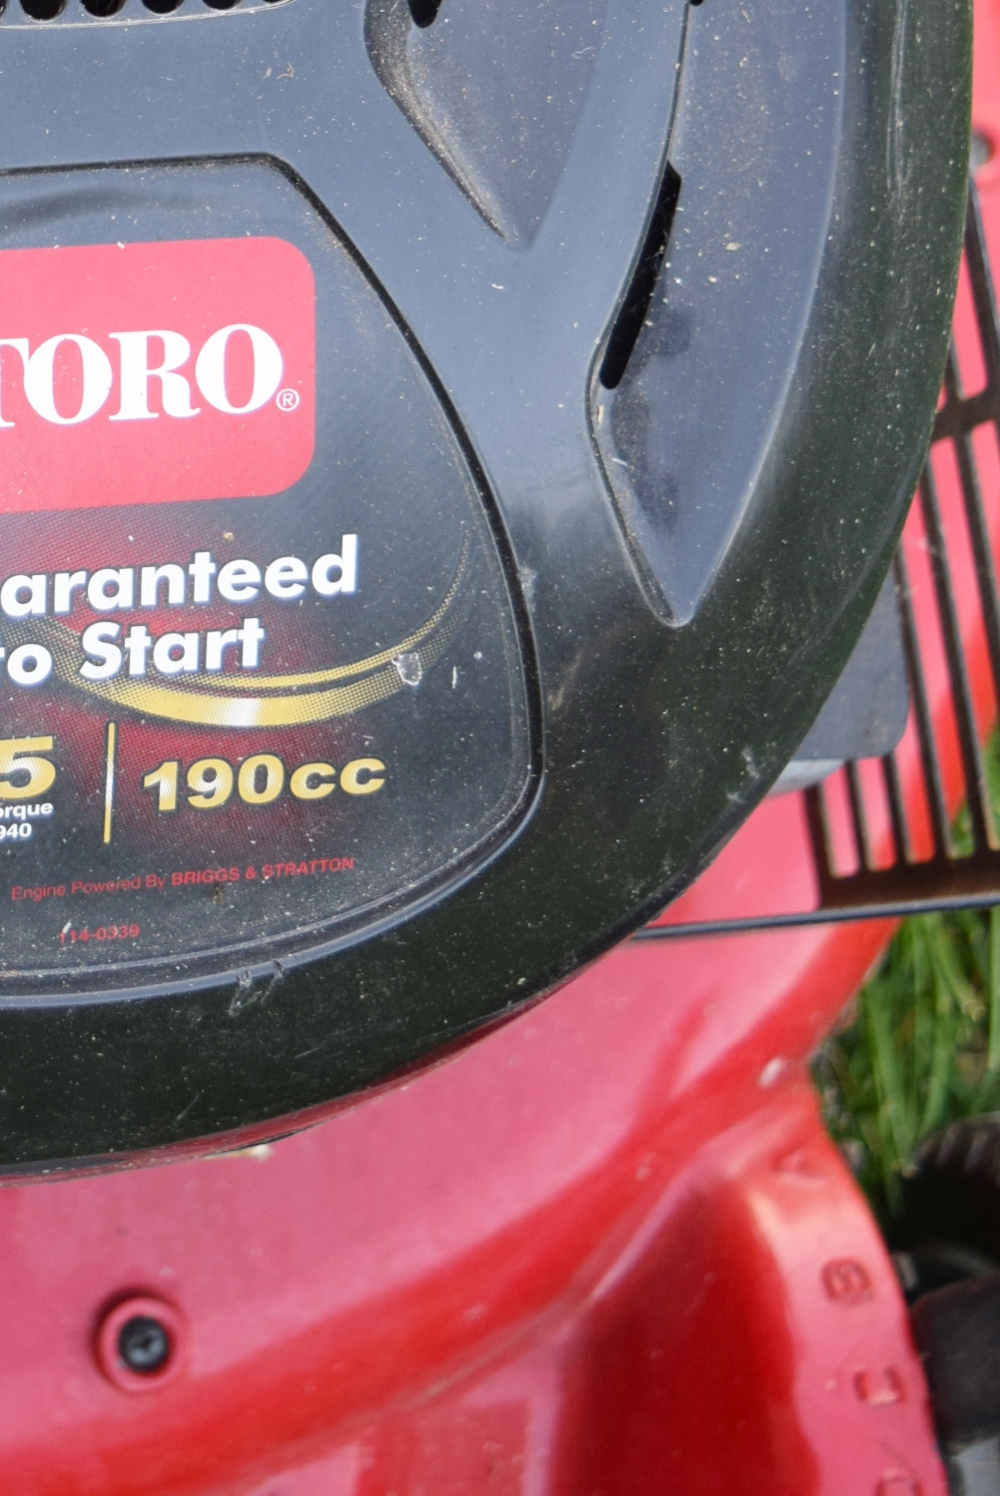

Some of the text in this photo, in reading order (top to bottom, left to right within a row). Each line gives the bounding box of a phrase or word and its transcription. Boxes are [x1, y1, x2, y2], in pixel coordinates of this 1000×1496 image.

[80, 618, 265, 680] Start
[143, 754, 386, 811] 190cc
[11, 857, 354, 902] Engine Powered By BRIGGS & STRATTON
[58, 923, 139, 944] 114-0339
